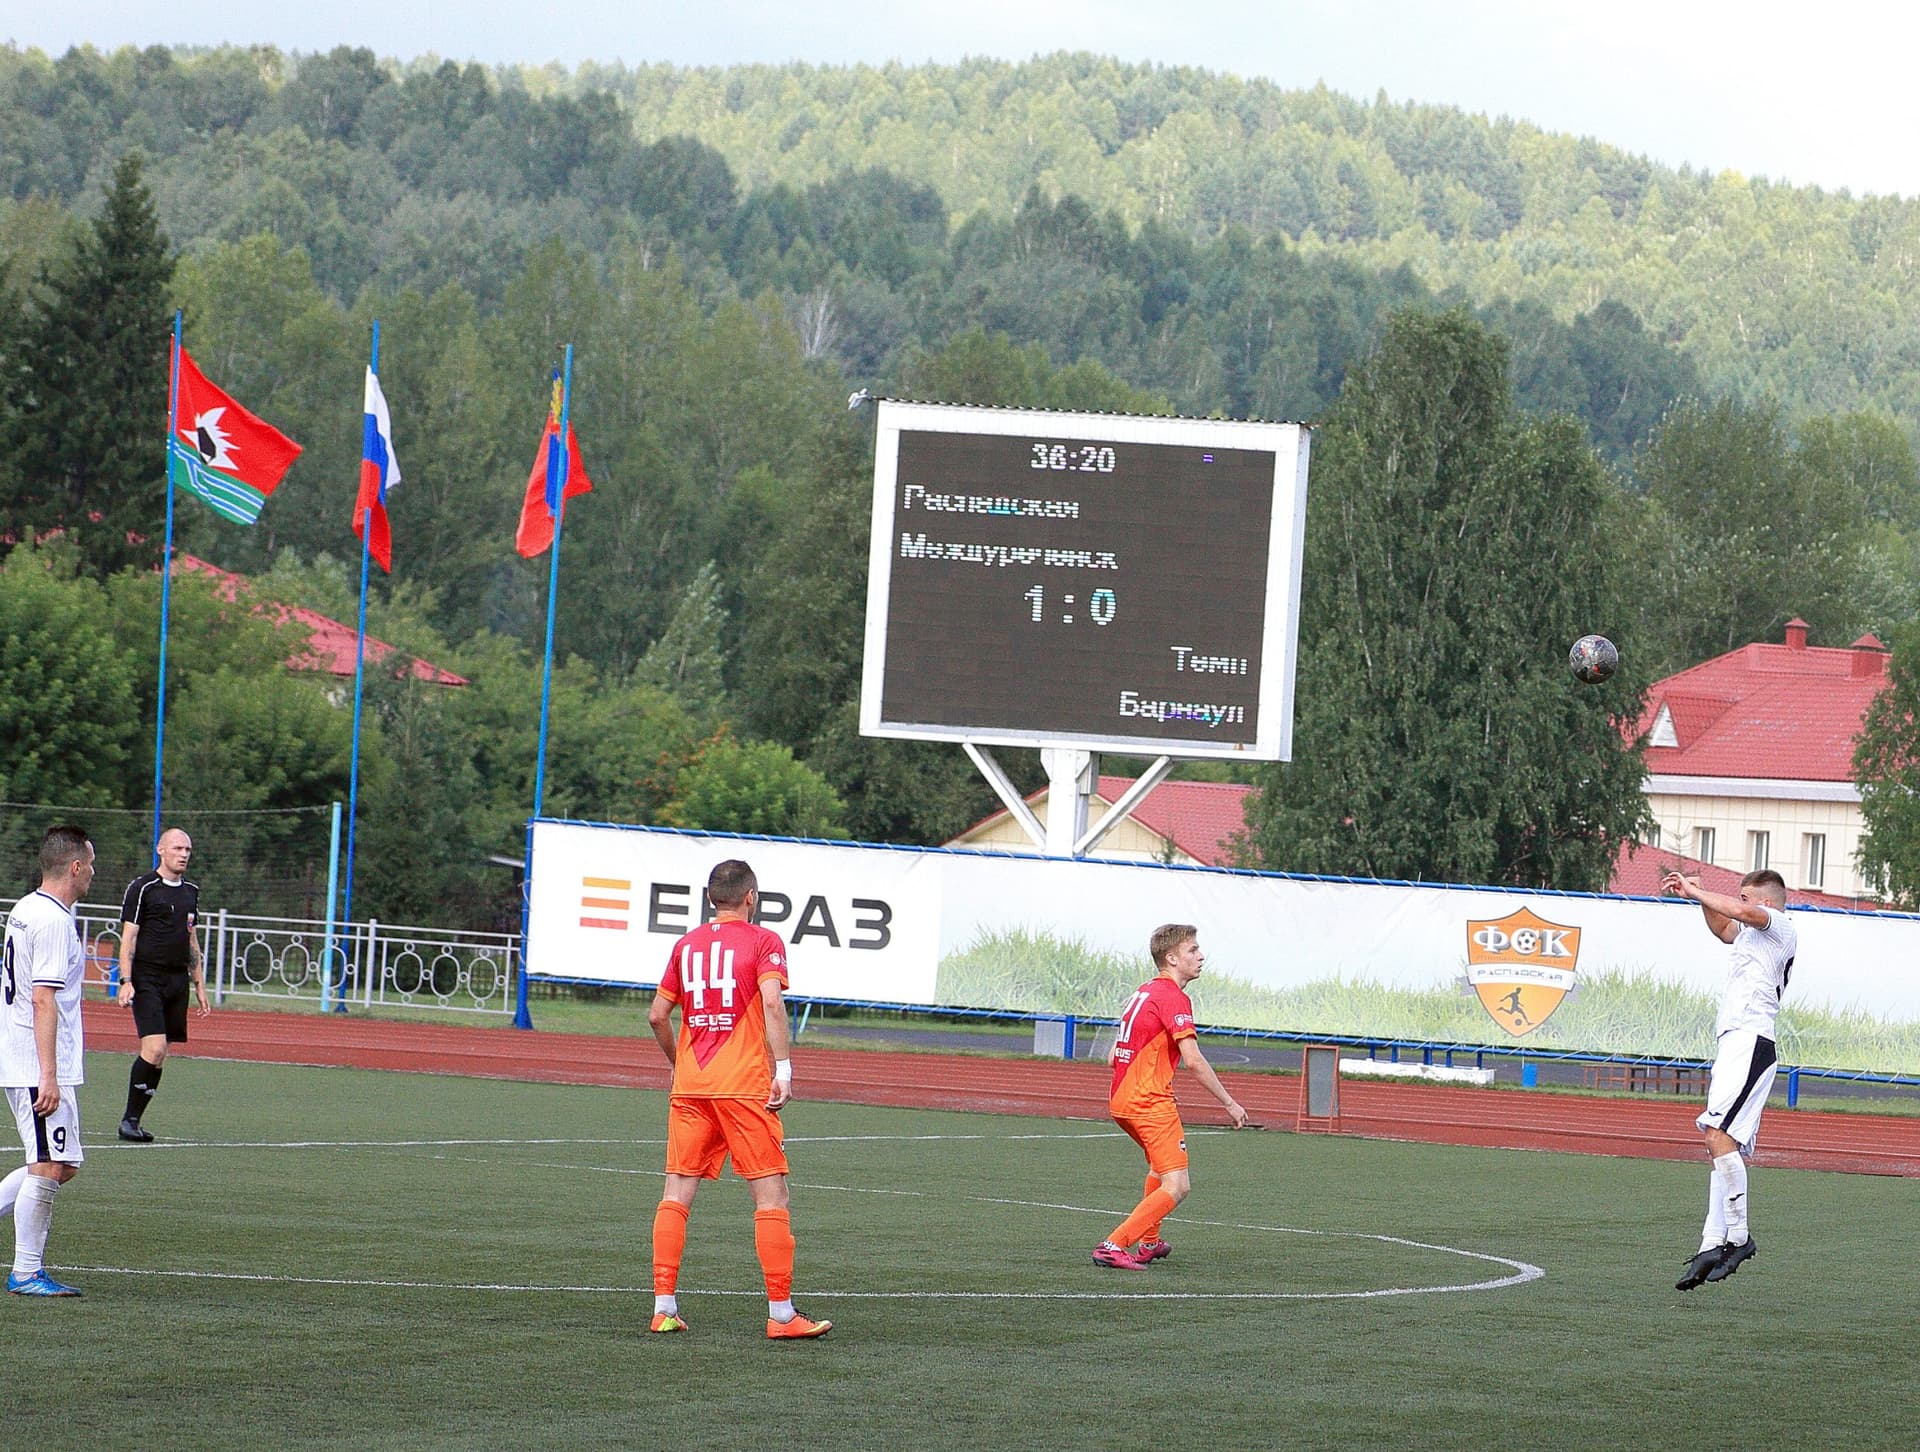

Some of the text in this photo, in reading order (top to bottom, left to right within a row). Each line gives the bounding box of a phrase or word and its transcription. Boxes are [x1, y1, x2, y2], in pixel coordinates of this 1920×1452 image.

[1025, 585, 1043, 621] 1
[1091, 589, 1116, 625] 0
[1171, 647, 1247, 674] Темп
[1120, 691, 1243, 727] Барнаул
[1473, 925, 1573, 957] ФСК
[4, 935, 16, 1005] 9
[681, 941, 736, 1009] 44
[688, 1013, 732, 1028] SEUS
[53, 1126, 66, 1153] 9
